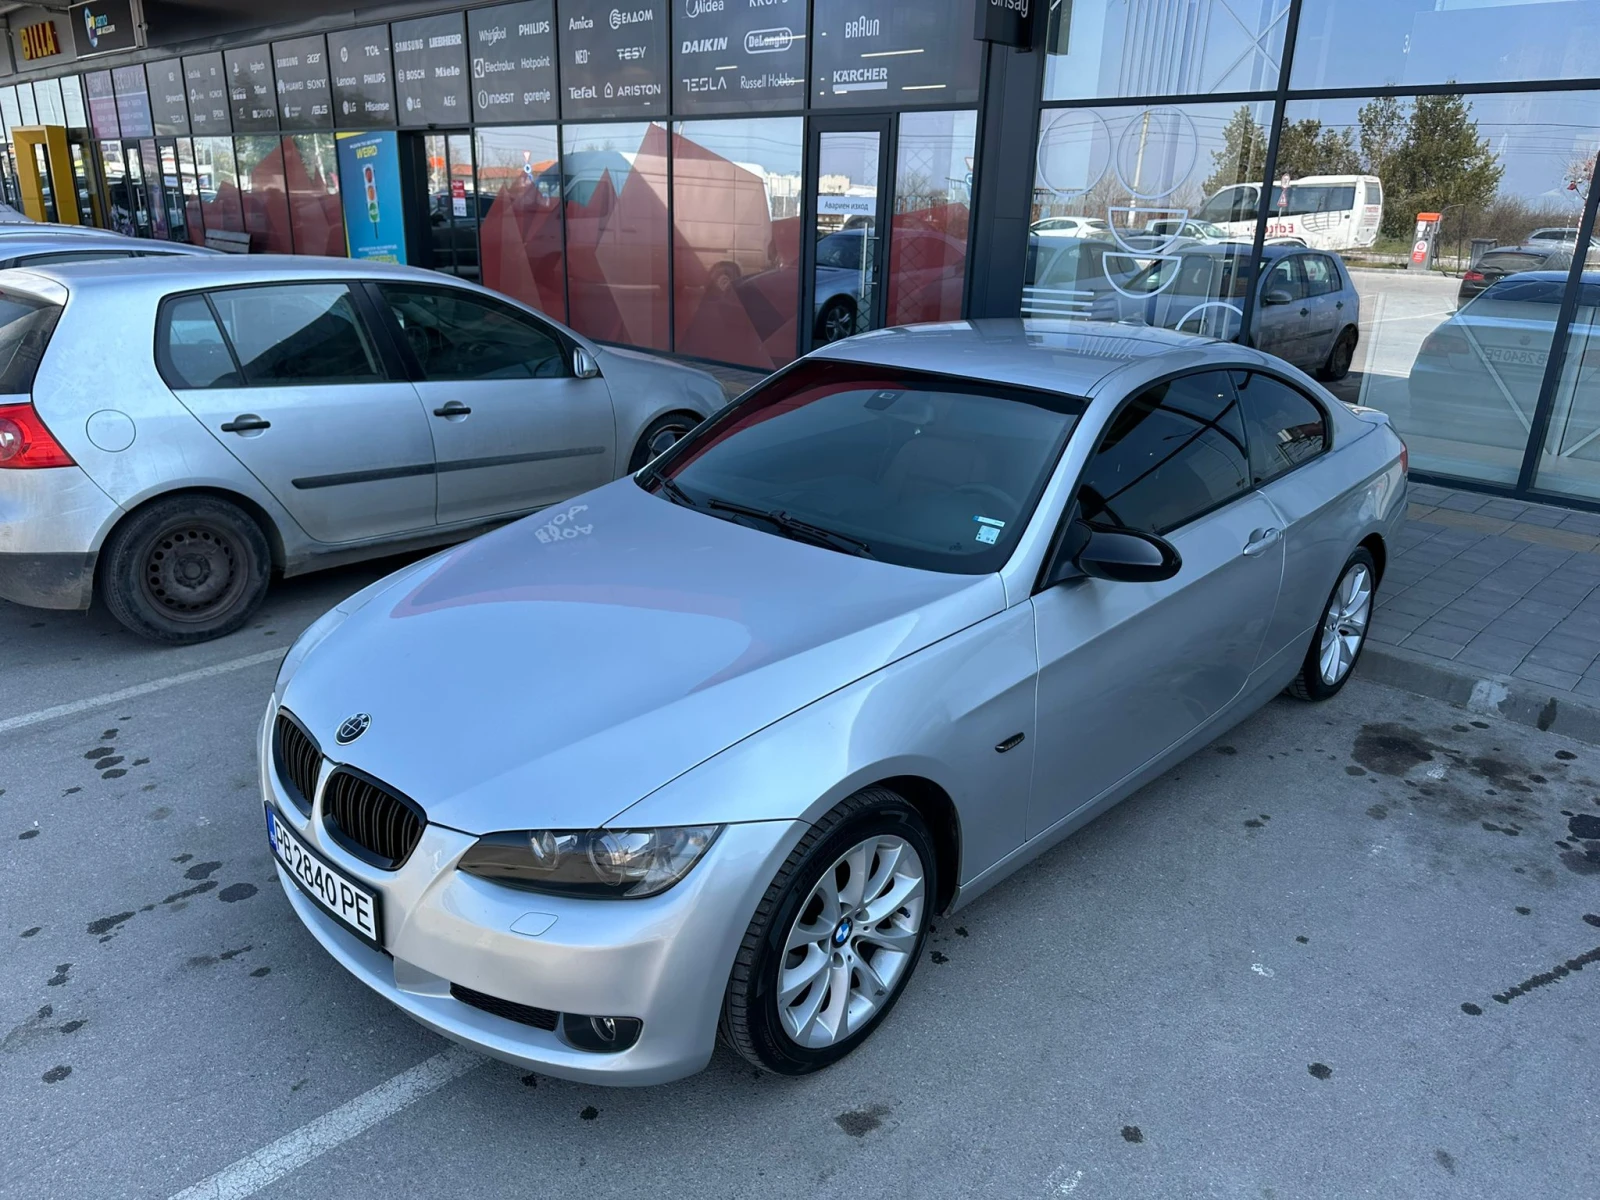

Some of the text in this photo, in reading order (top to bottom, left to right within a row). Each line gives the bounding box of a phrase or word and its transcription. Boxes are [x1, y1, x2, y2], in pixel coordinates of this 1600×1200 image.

[519, 21, 549, 36] PHILIPS
[569, 16, 593, 30] Amica
[845, 16, 880, 38] BRAUN
[20, 21, 56, 60] BILLA
[429, 34, 462, 48] LIEBHERR
[479, 27, 506, 45] Whirlpool
[395, 39, 424, 52] SAMSUNG
[681, 37, 728, 54] DAIKIN
[307, 53, 321, 63] acer
[617, 46, 646, 60] TESY
[277, 56, 298, 68] SAMSUNG
[485, 60, 515, 73] Electrolux
[521, 56, 550, 71] Hotpoint
[363, 73, 386, 84] PHILIPS
[406, 69, 425, 80] BOSCH
[435, 66, 460, 78] Miele
[833, 67, 888, 82] KÄRCHER
[306, 79, 326, 90] SONY
[336, 77, 356, 86] Lenovo
[683, 77, 727, 91] TESLA
[741, 73, 795, 89] Russell Hobbs
[524, 88, 550, 105] gorenje
[569, 86, 597, 99] Tefal
[617, 84, 661, 97] ARISTON
[365, 101, 390, 112] Hisense
[443, 95, 456, 107] AEG
[274, 819, 372, 933] PB 2840 PE
